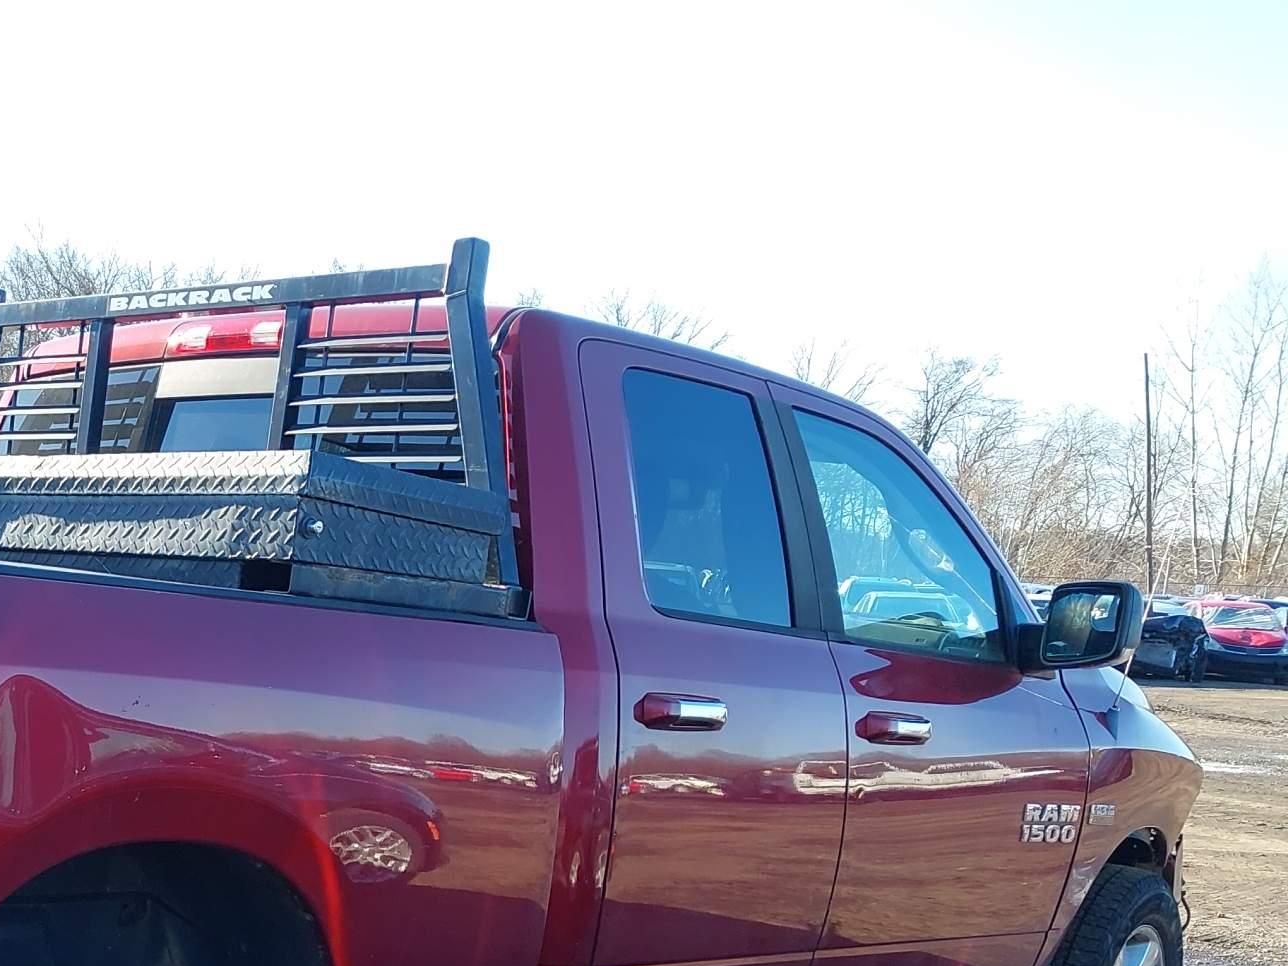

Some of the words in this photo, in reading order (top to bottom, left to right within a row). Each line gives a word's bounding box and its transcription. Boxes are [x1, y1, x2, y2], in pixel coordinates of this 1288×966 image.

[109, 284, 272, 312] BACKRACK
[1024, 803, 1080, 822] RAM
[1021, 824, 1076, 843] 1500
